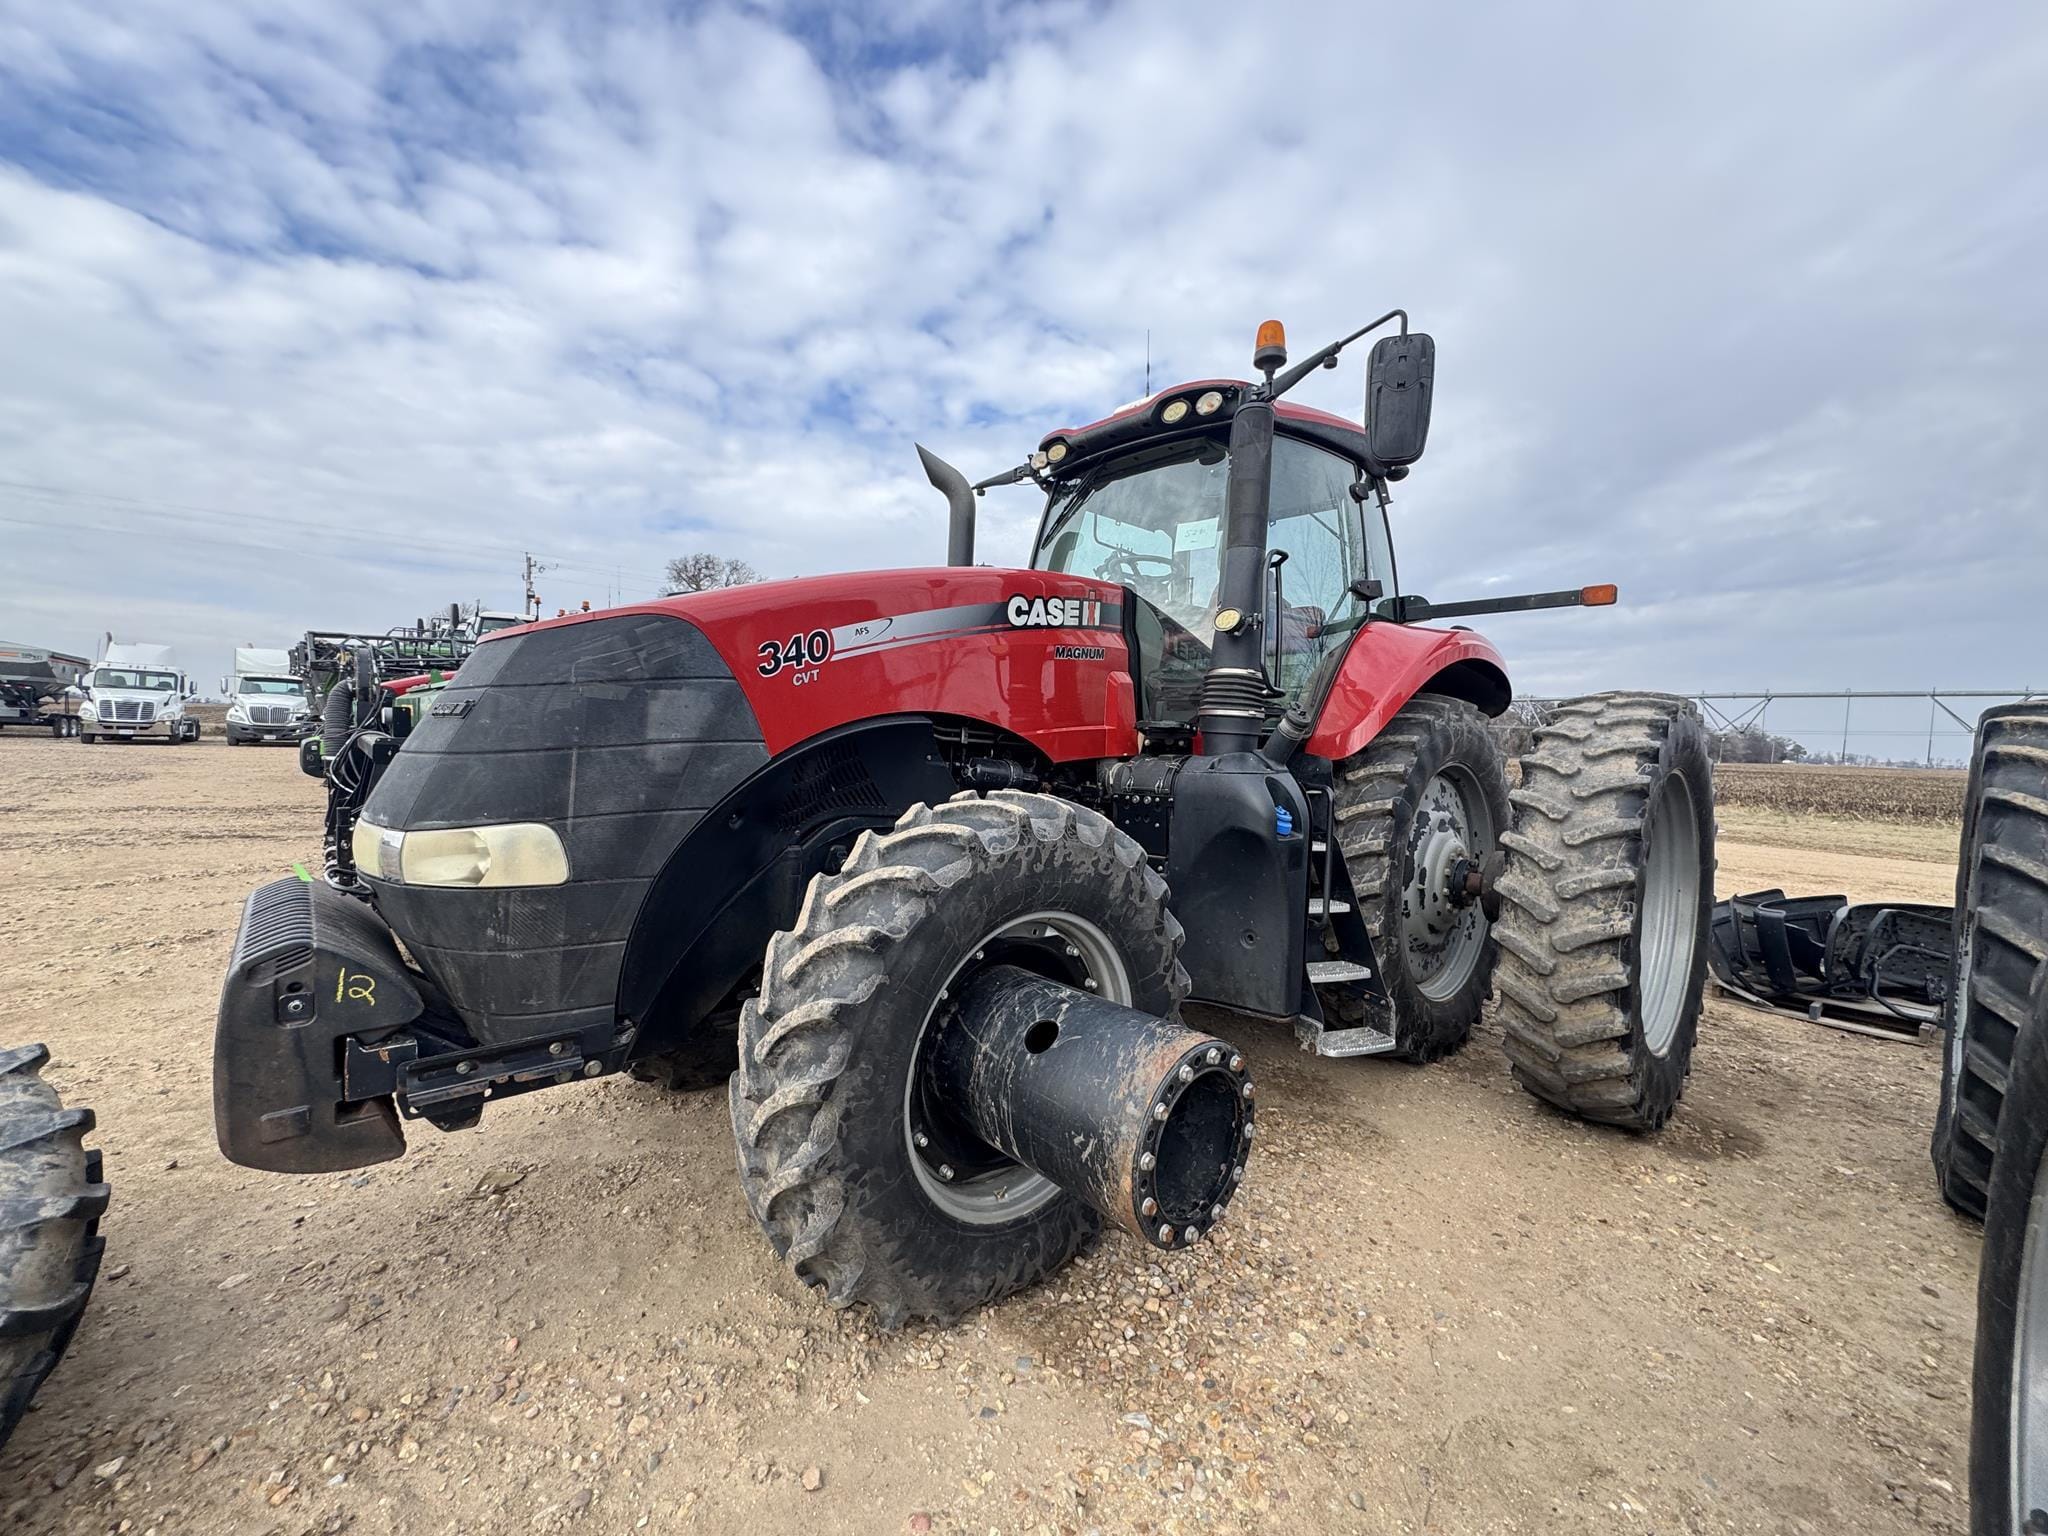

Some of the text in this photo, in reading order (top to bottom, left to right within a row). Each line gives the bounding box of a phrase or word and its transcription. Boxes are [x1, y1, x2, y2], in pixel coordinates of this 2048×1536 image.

[855, 626, 870, 636] AFS
[757, 628, 830, 678] 340
[1054, 646, 1105, 660] MAGNUM
[792, 669, 819, 686] CVT
[335, 967, 376, 1006] 12
